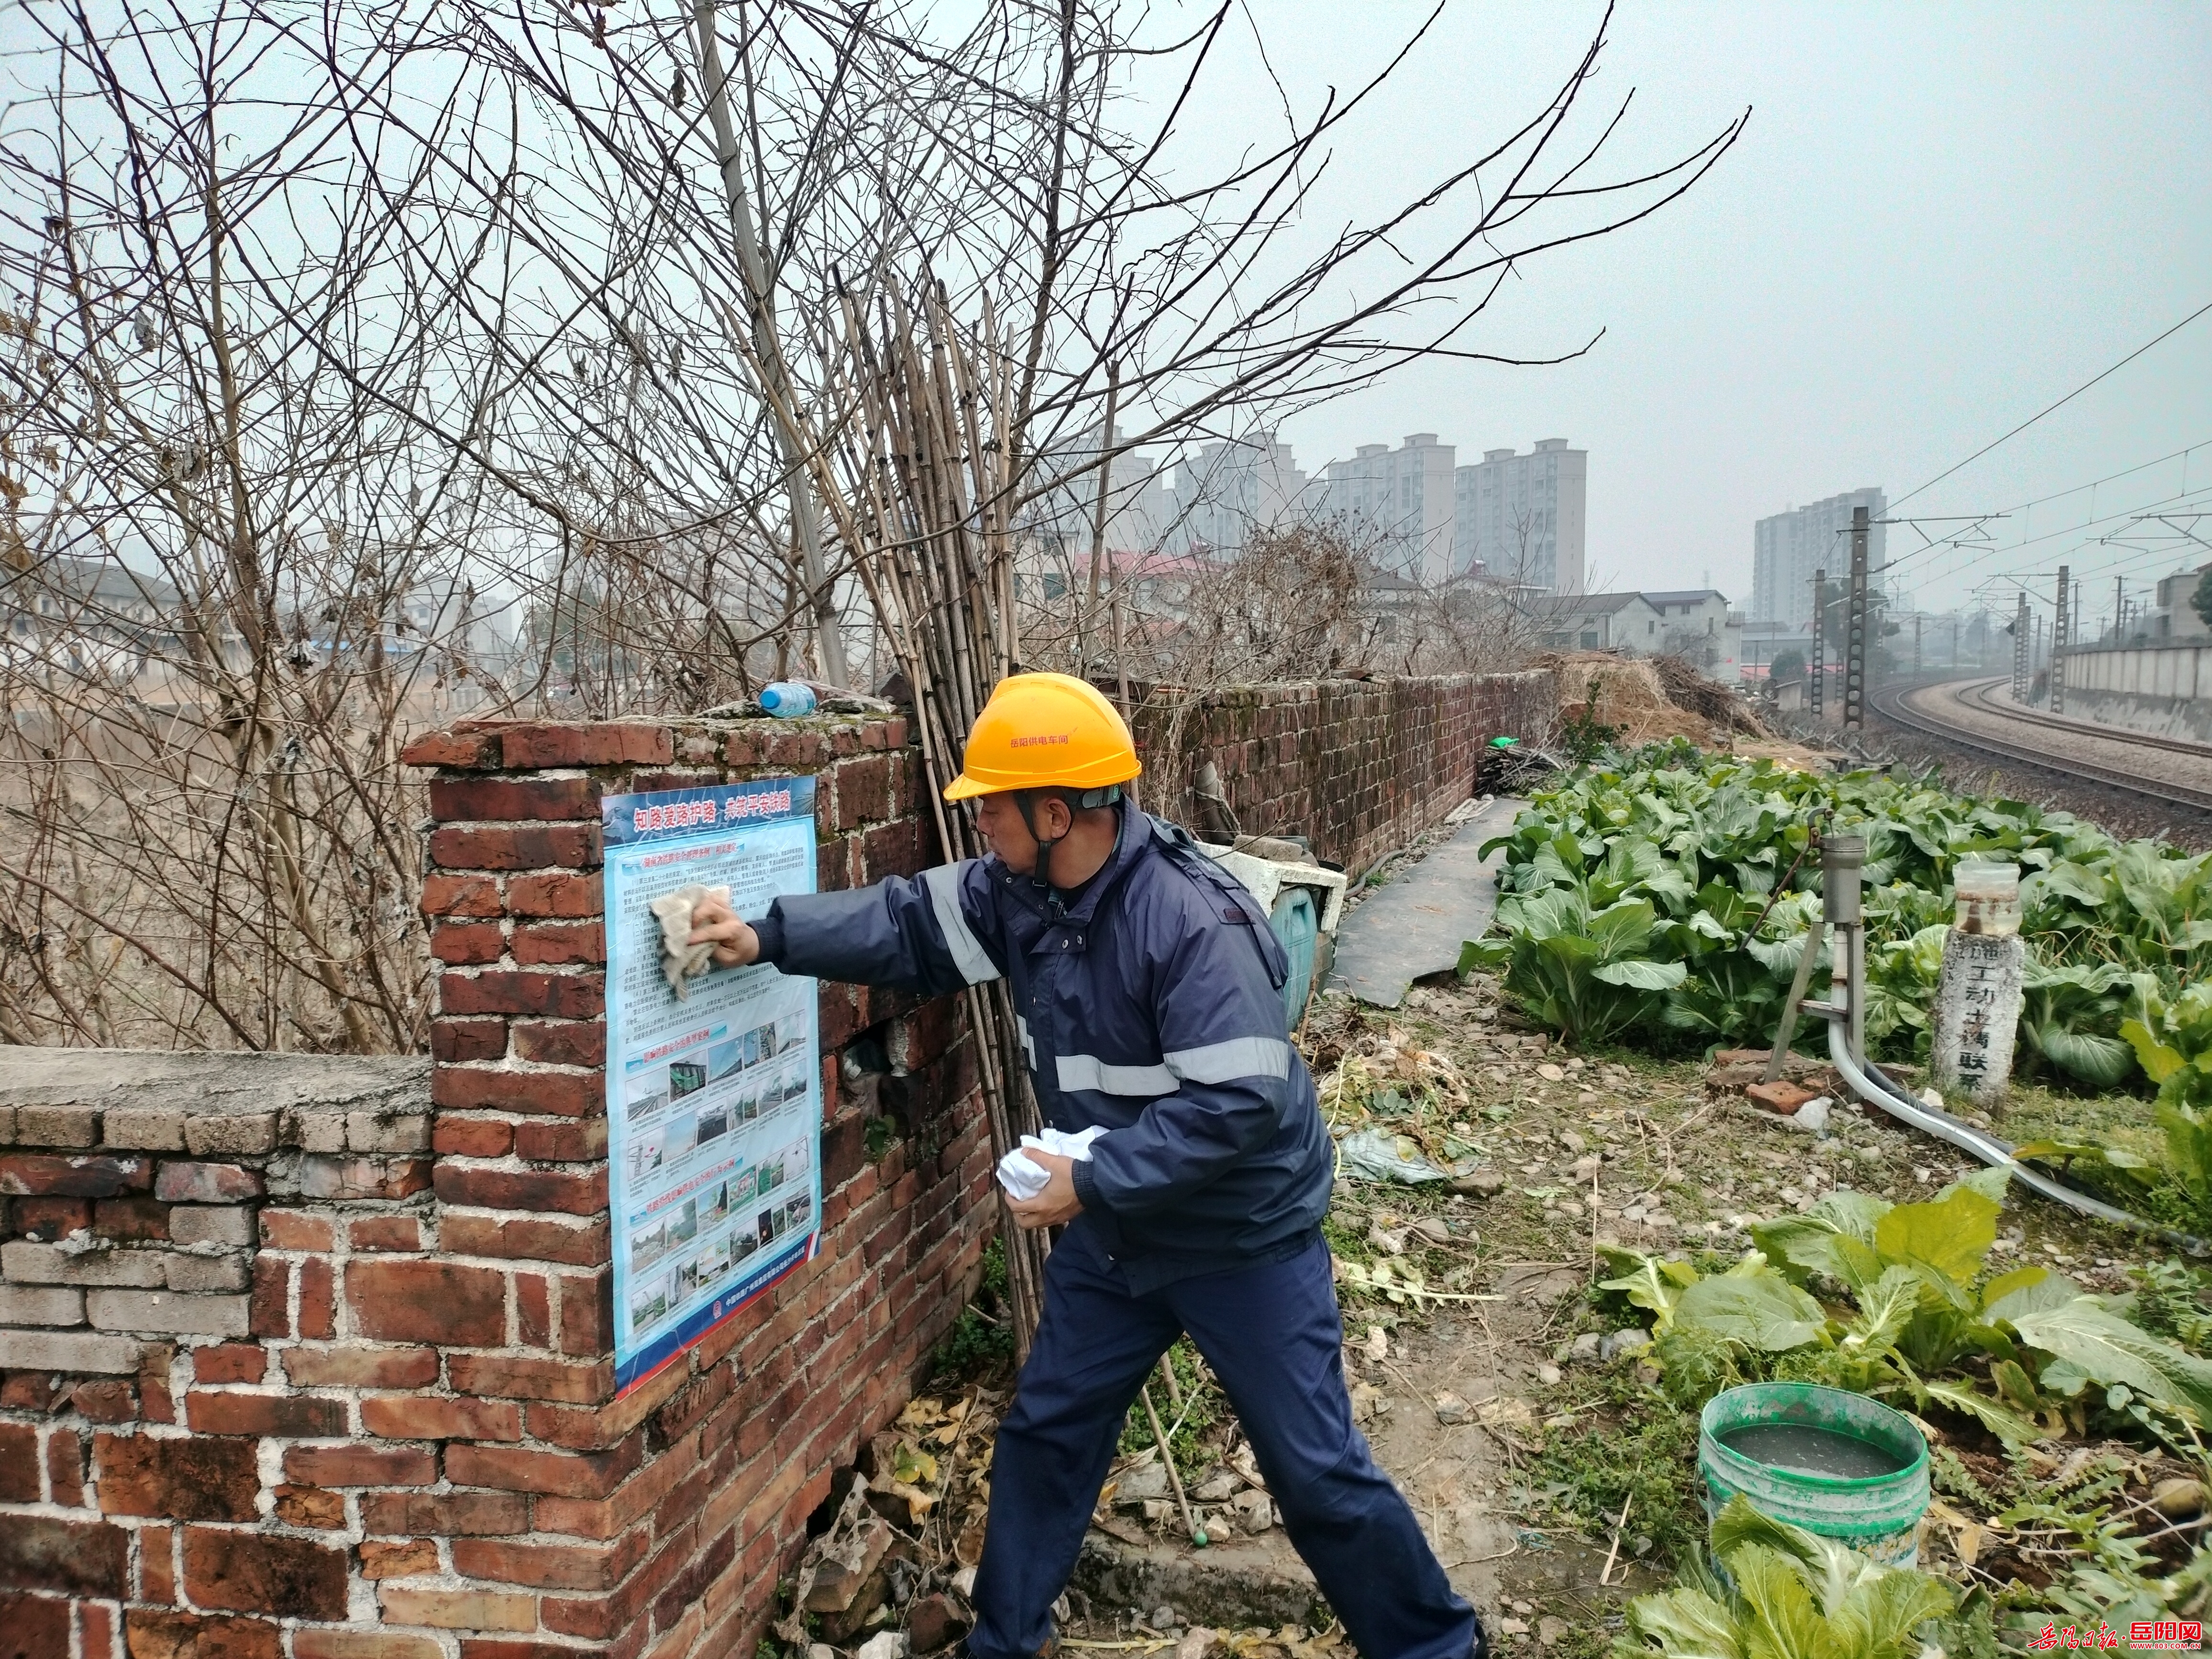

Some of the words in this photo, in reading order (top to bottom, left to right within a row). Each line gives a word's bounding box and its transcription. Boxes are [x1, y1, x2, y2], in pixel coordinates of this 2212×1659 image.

[1010, 735, 1068, 748] 岳阳供电车间
[634, 800, 716, 832] 知路爱路护路
[724, 789, 790, 820] 共筑平安铁路
